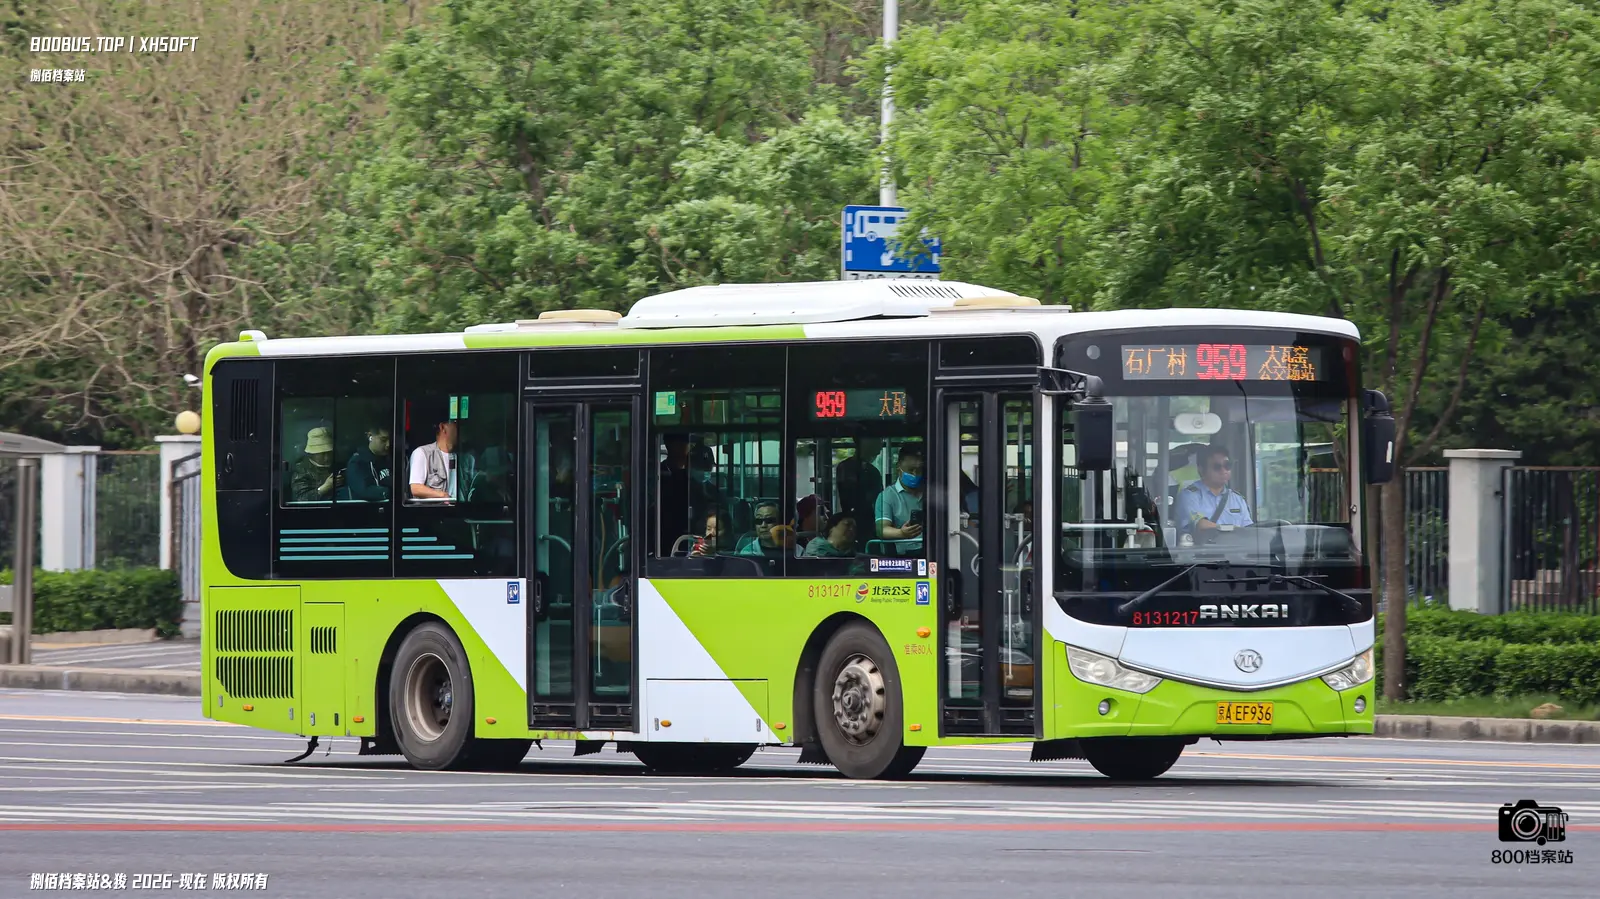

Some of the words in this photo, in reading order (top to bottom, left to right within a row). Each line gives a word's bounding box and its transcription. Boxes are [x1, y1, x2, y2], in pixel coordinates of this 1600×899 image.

[1125, 347, 1187, 376] 石厂村
[1196, 344, 1247, 380] 959
[1264, 345, 1309, 364] 大瓦窑
[1258, 363, 1315, 381] 公交场站
[815, 390, 846, 418] 959
[808, 584, 851, 598] 8131217
[872, 585, 911, 596] 北京公交
[1133, 611, 1198, 625] 8131217
[1200, 604, 1289, 618] ANKAI
[904, 643, 933, 655] 准乘80人
